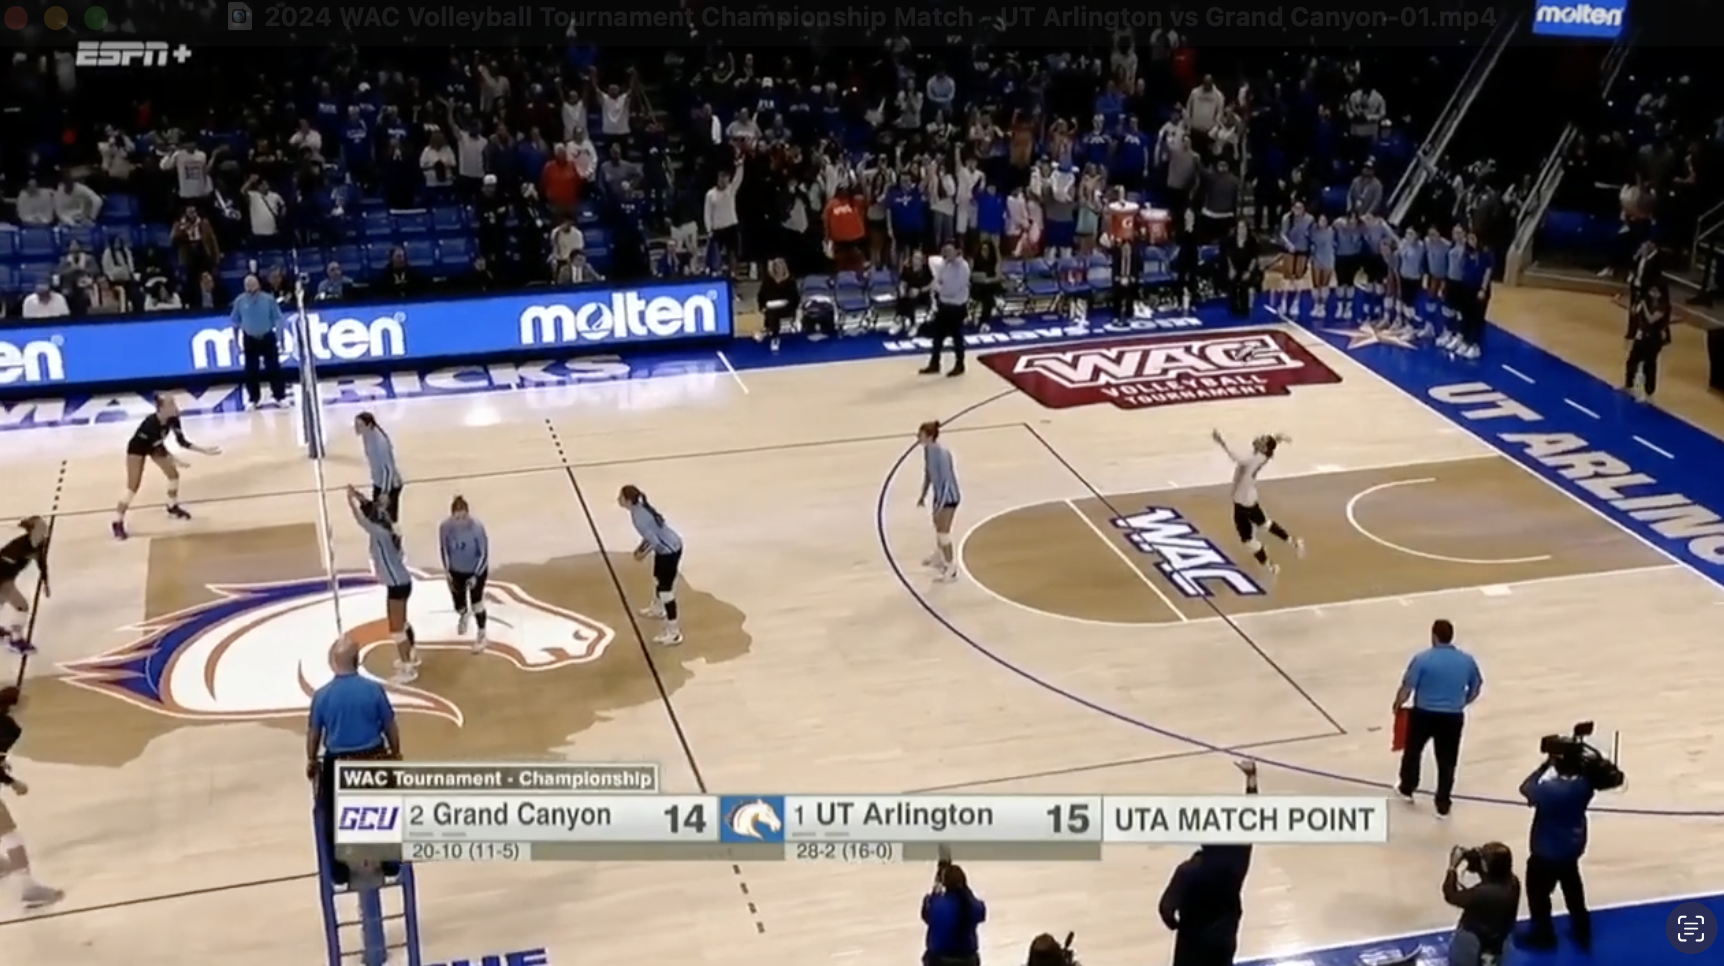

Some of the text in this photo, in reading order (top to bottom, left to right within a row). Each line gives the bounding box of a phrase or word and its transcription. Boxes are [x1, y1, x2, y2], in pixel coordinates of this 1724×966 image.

[1536, 4, 1623, 26] molten
[520, 291, 719, 345] molten
[1013, 334, 1305, 388] WAC
[1101, 374, 1268, 398] VOLLEYBALL
[1125, 385, 1266, 405] TOURNAMENT
[1428, 381, 1544, 422] UT
[1109, 506, 1267, 597] WAC
